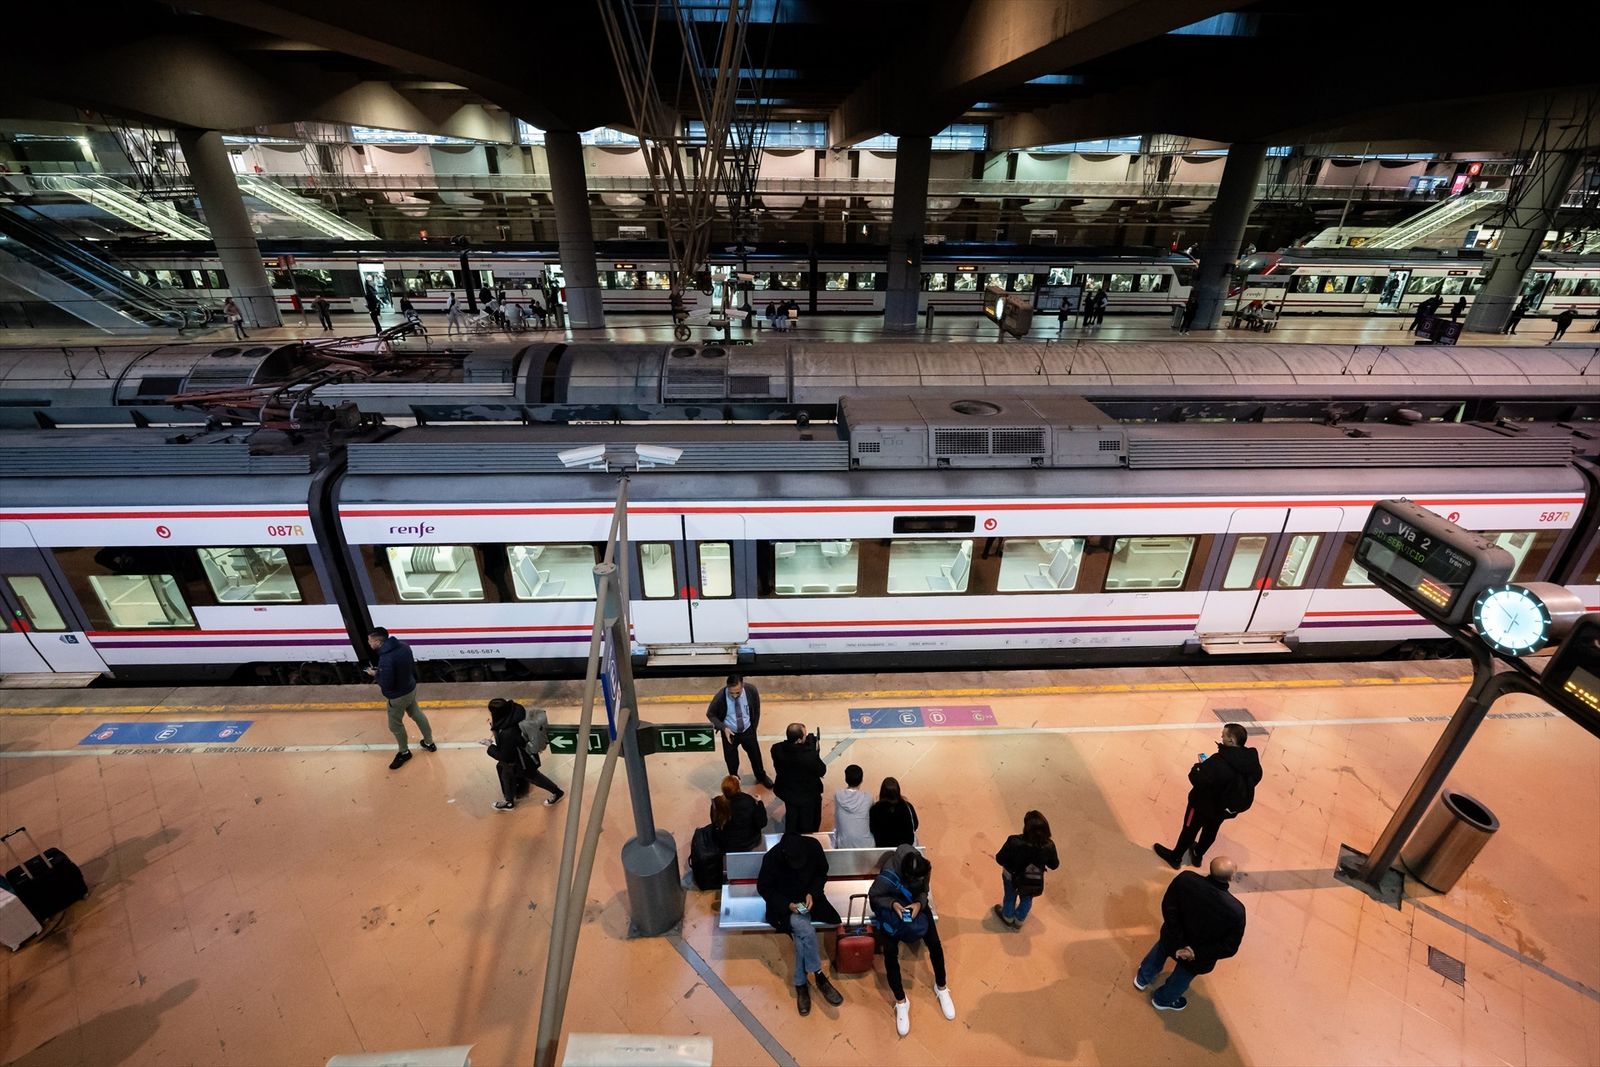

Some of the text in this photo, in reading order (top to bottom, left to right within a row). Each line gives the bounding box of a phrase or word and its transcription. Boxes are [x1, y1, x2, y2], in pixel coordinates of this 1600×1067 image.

[1539, 511, 1570, 521] 587R
[267, 525, 304, 536] 087R
[389, 521, 435, 539] renfe
[1420, 538, 1432, 550] 2
[1448, 558, 1462, 569] tren
